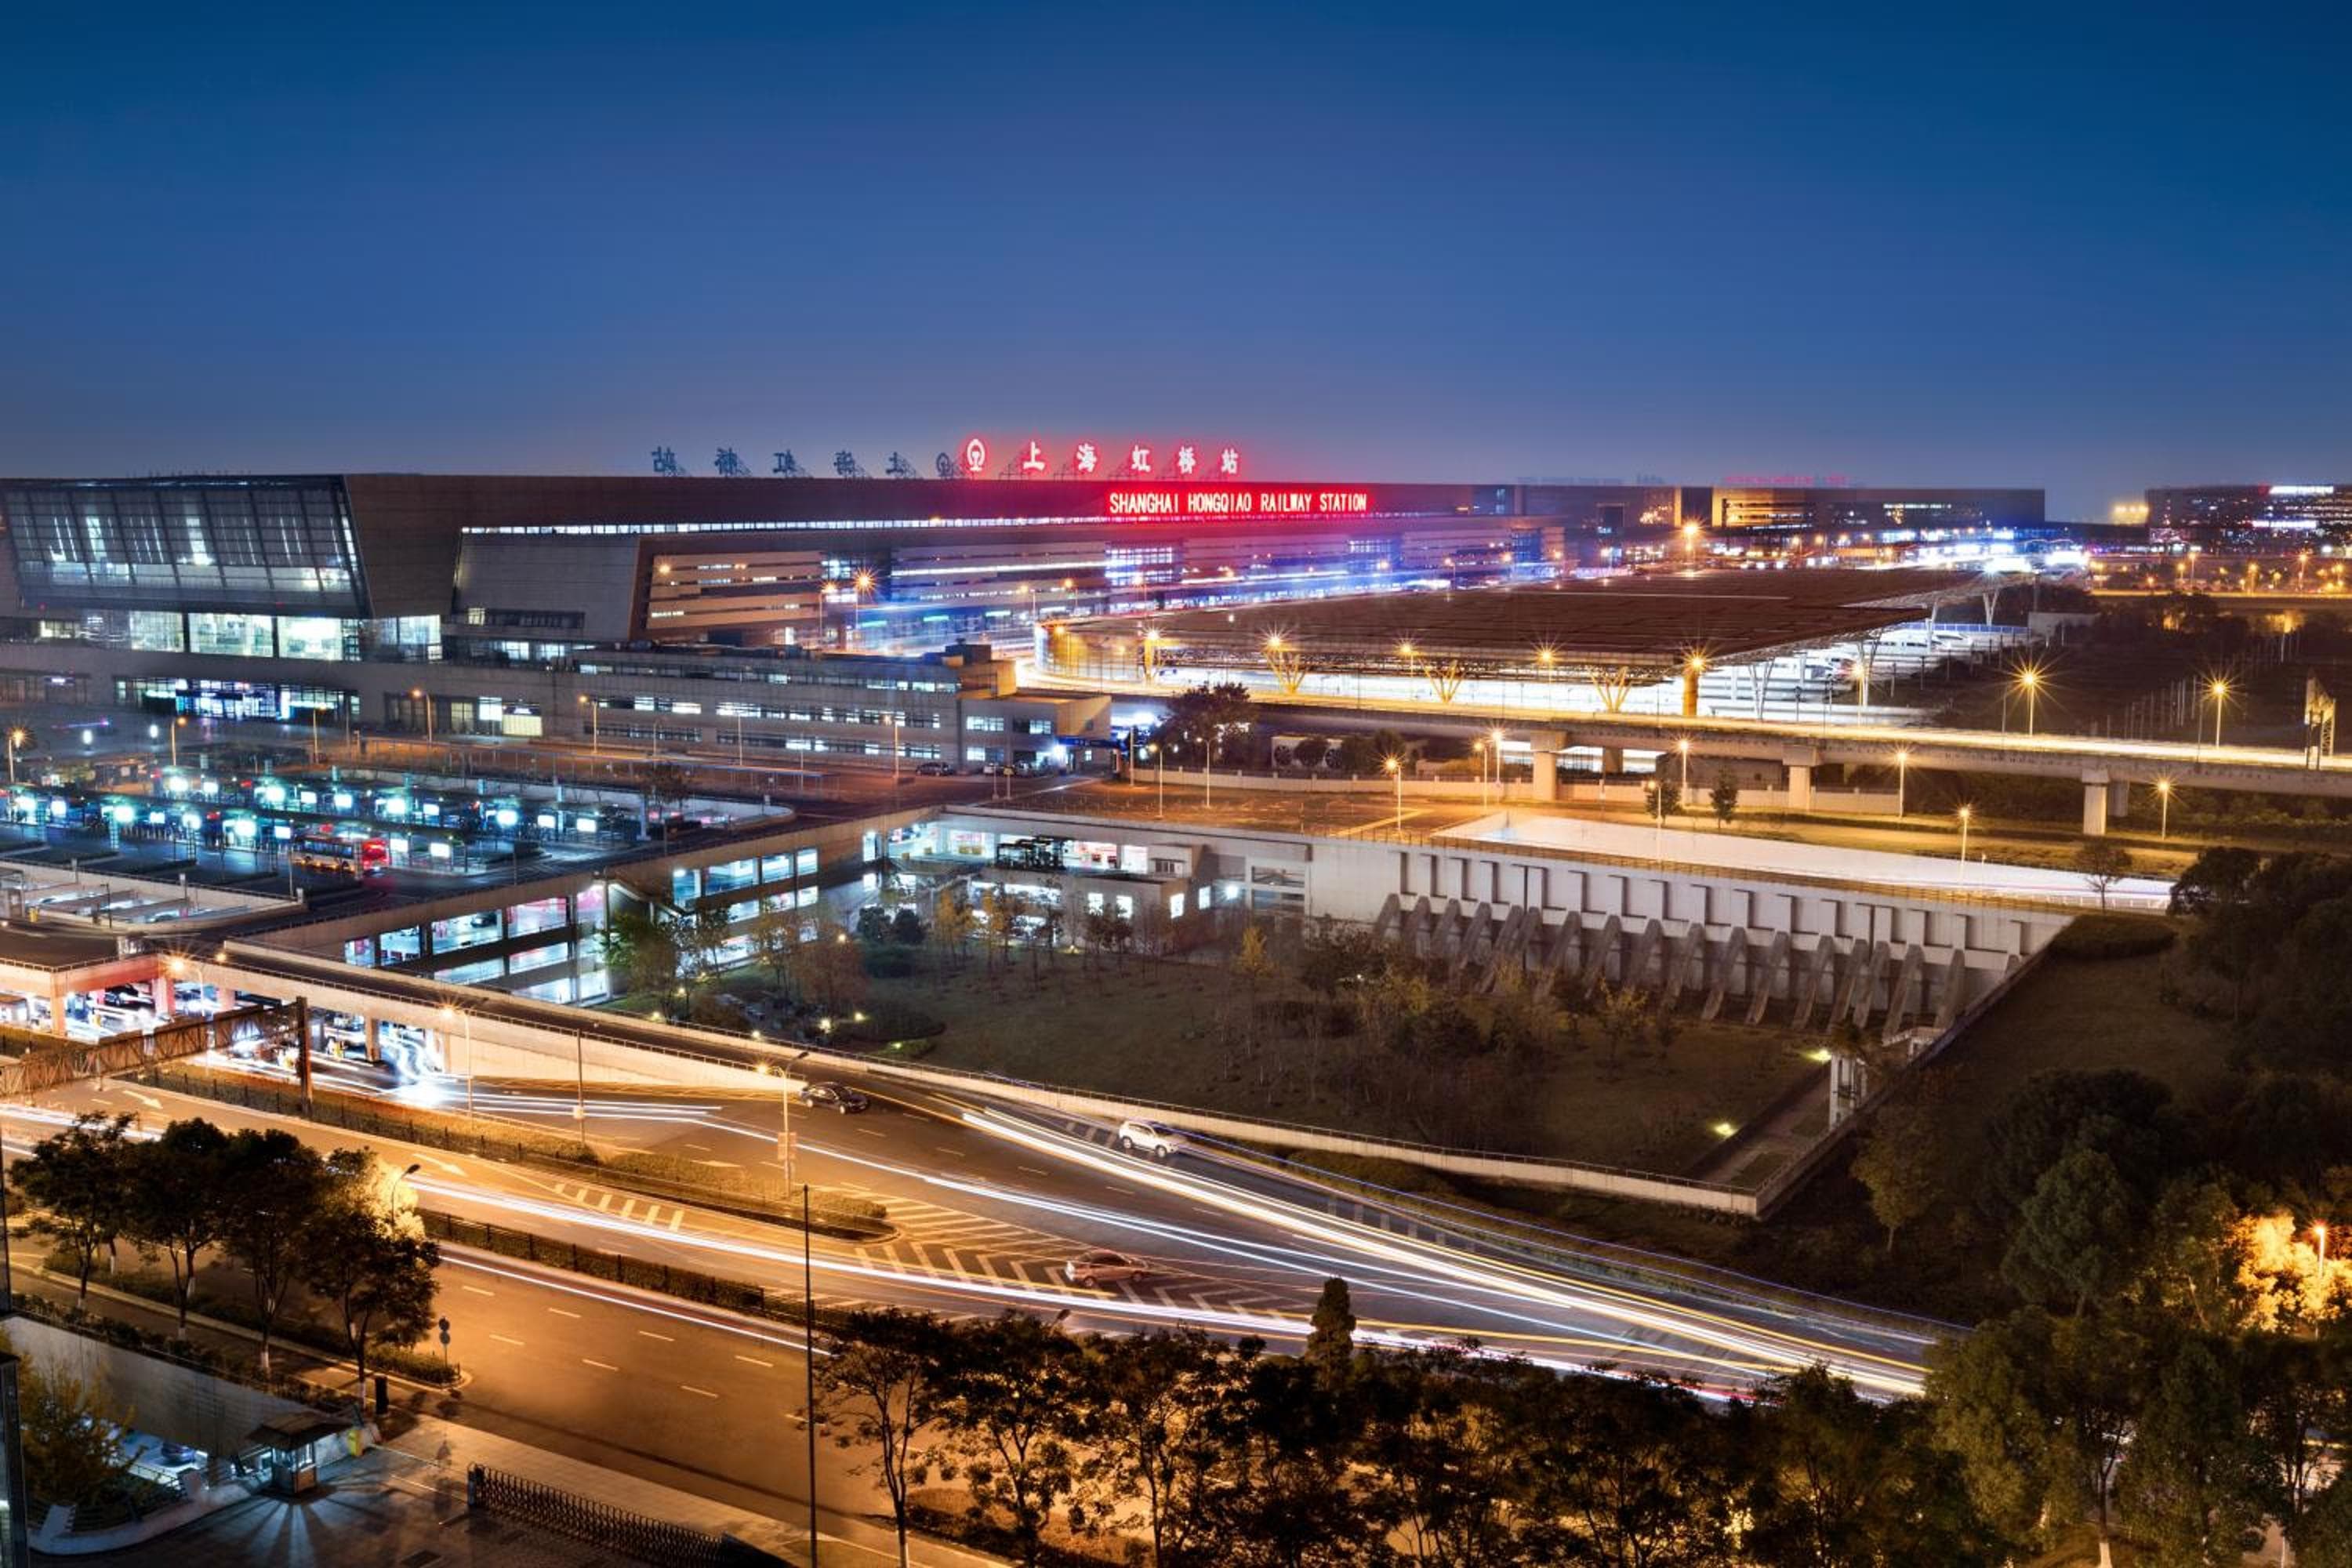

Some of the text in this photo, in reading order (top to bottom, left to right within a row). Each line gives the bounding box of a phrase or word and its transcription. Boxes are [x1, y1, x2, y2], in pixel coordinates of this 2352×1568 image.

[1022, 441, 1239, 474] 上海虹桥站
[1109, 492, 1367, 514] SHANGHAI HONGQIAO RAILWAY STATION
